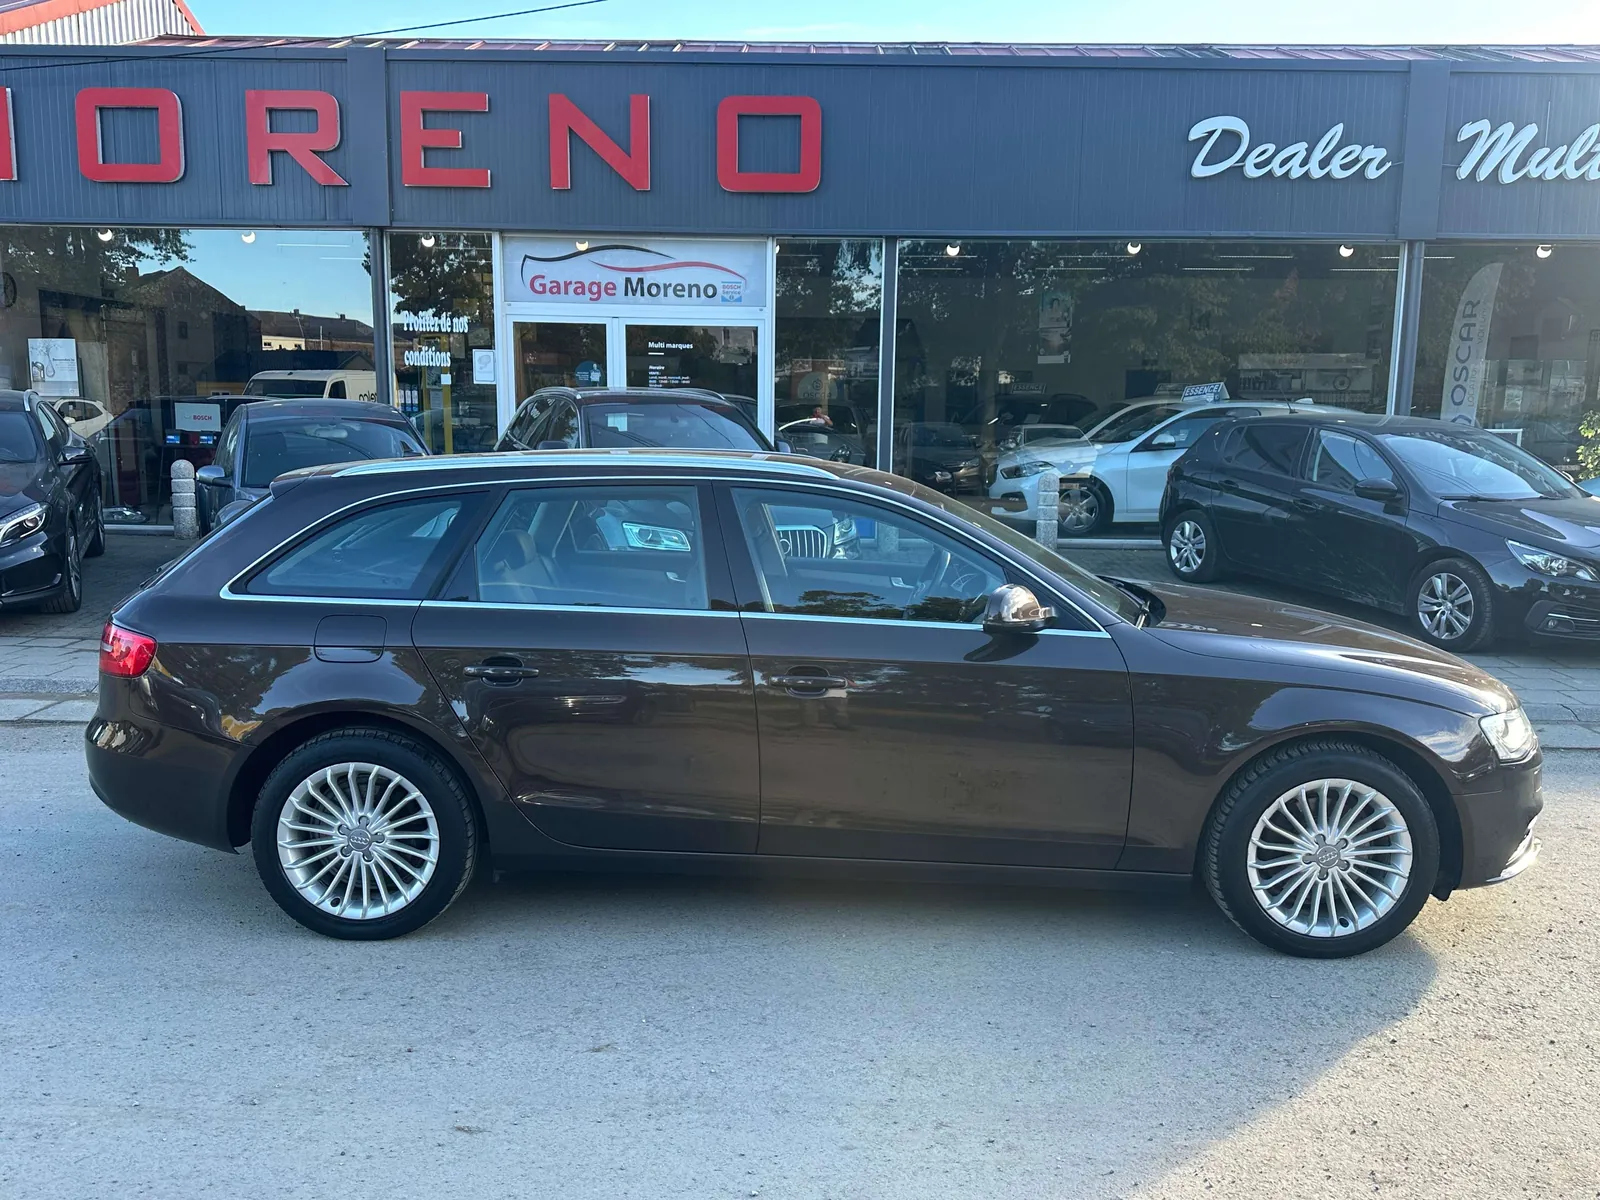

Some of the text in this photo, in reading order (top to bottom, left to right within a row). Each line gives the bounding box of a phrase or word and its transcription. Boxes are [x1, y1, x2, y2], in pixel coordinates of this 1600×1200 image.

[0, 86, 823, 193] ORENO
[1188, 115, 1392, 180] Dealer
[529, 274, 718, 302] Garage Moreno
[403, 309, 469, 333] Profitez de nos
[404, 345, 451, 367] conditions
[648, 341, 665, 349] Multi
[1450, 299, 1481, 407] OSCAR
[1184, 383, 1219, 396] ESSENCE
